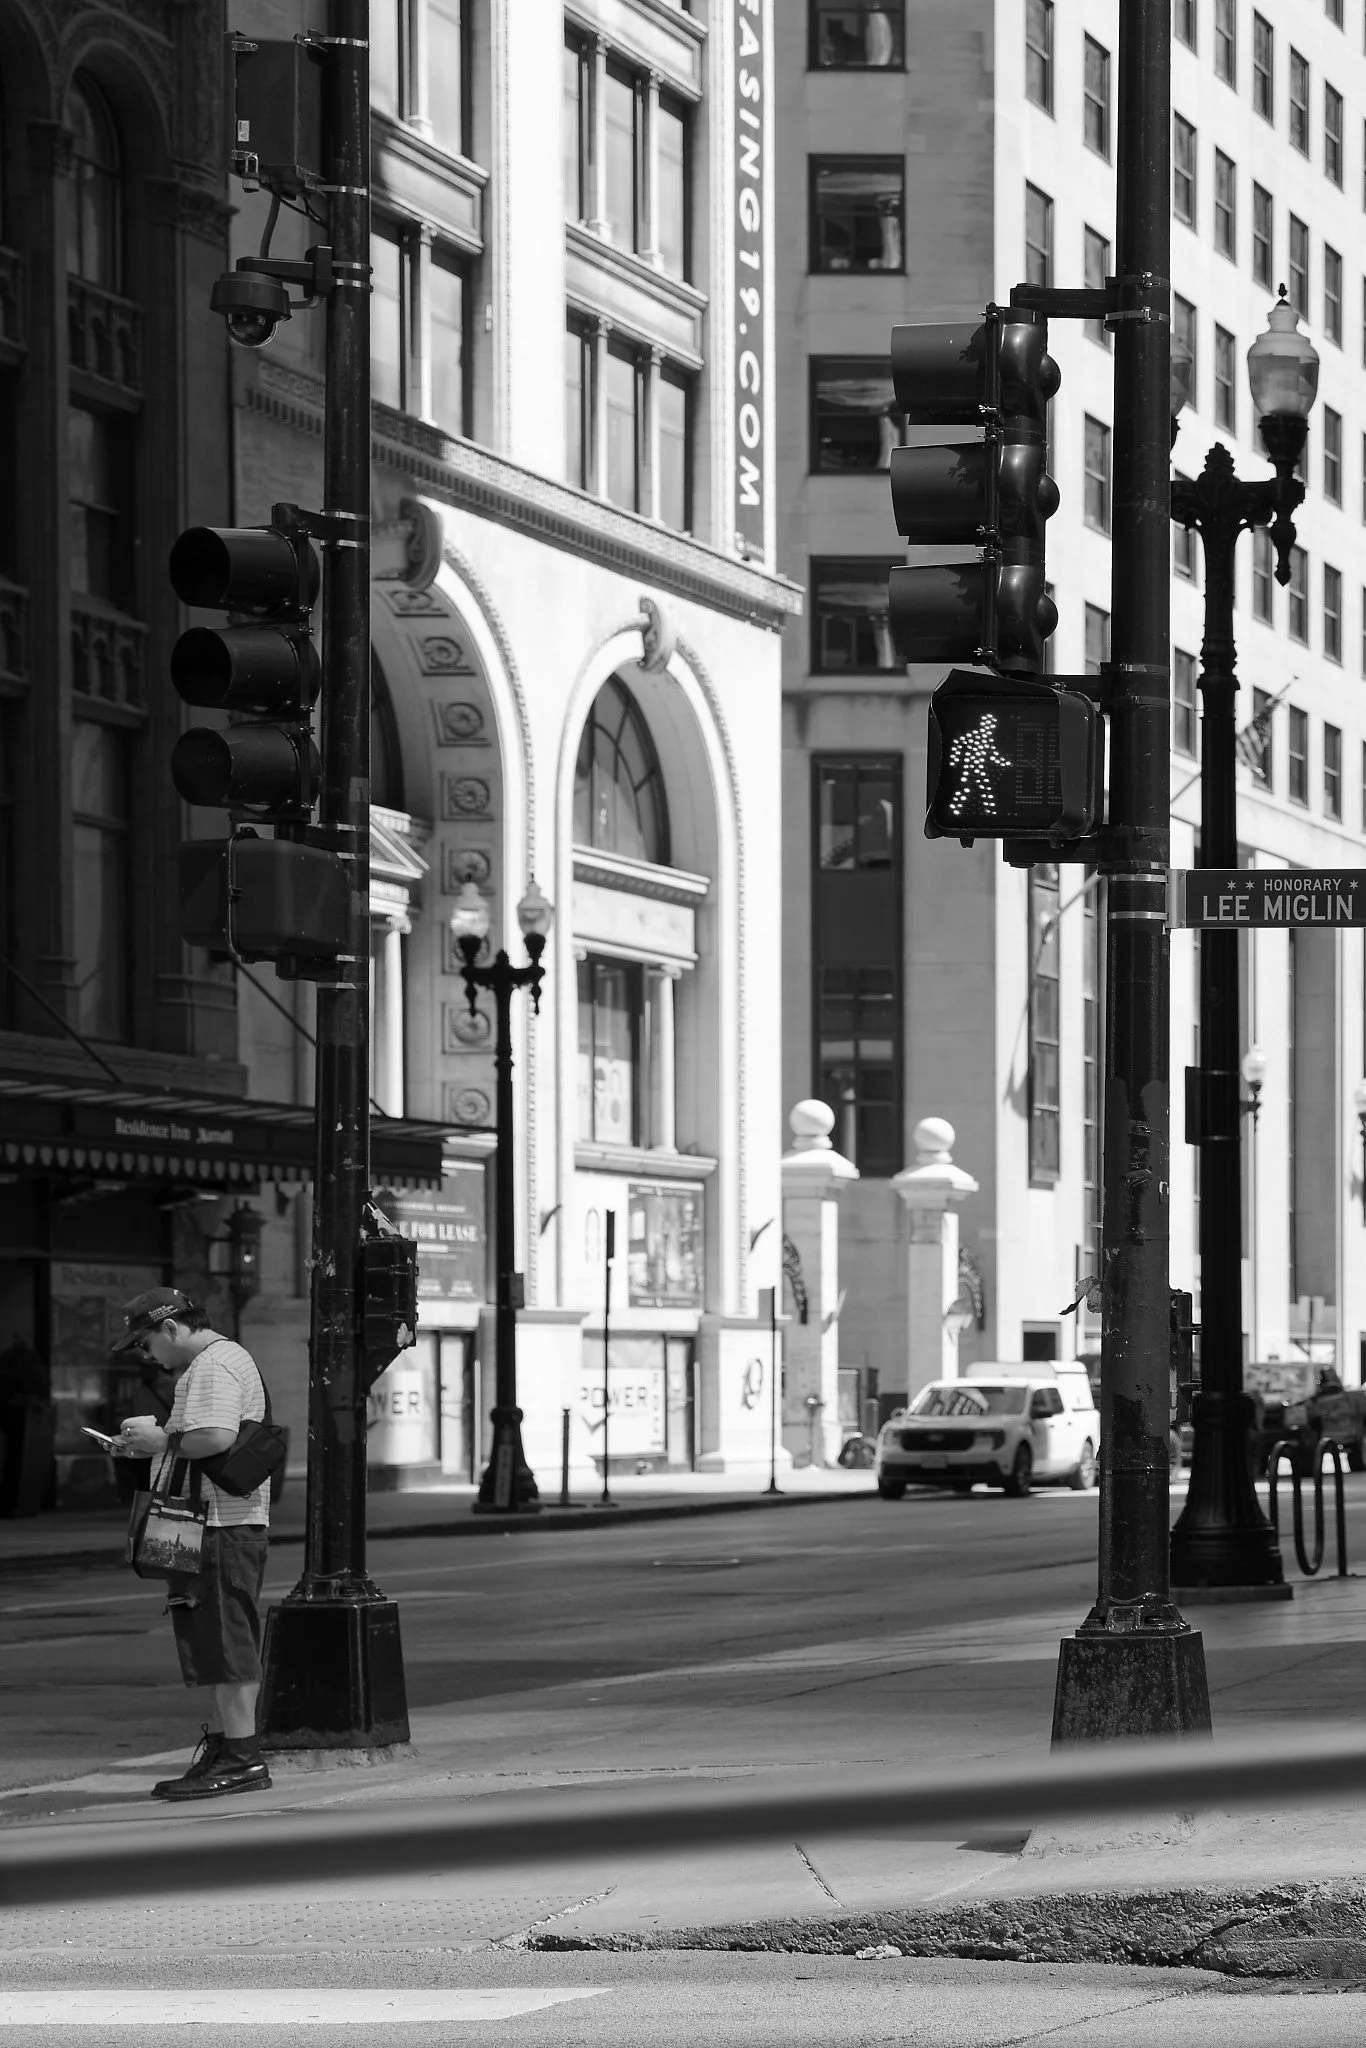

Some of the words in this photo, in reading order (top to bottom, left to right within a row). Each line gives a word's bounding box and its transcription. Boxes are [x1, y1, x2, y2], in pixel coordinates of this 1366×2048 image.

[1264, 878, 1343, 892] HONORARY
[1203, 895, 1251, 921] LEE
[1264, 895, 1354, 921] MIGLIN
[411, 1221, 437, 1240] FOR
[439, 1222, 478, 1242] LEASE
[371, 1391, 420, 1415] WER
